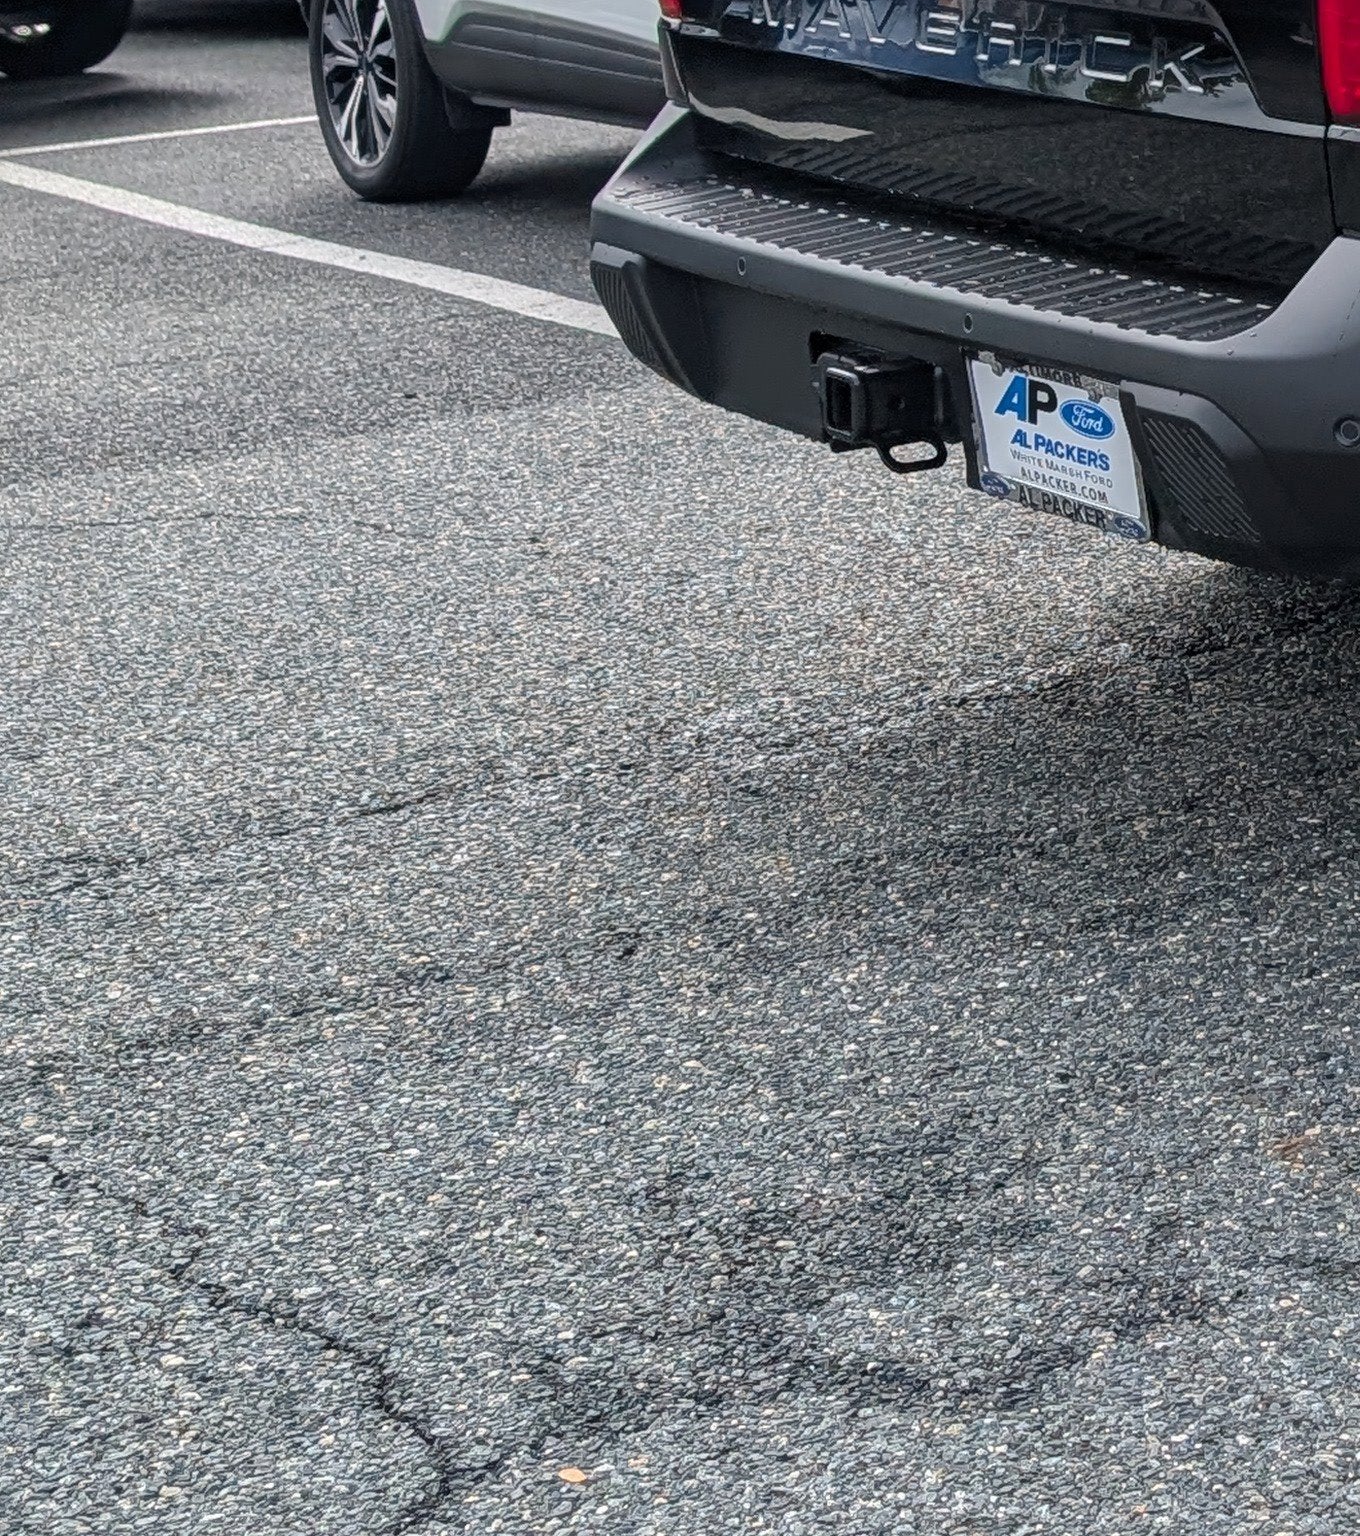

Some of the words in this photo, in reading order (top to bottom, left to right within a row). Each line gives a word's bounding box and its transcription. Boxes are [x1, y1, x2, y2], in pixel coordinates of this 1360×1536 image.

[994, 374, 1058, 426] AP
[1072, 404, 1105, 433] Ford
[1010, 428, 1033, 450] AL
[1034, 432, 1111, 472] PACKER'S
[1020, 466, 1110, 505] ALPACKER.COM
[1040, 491, 1108, 533] PACKER
